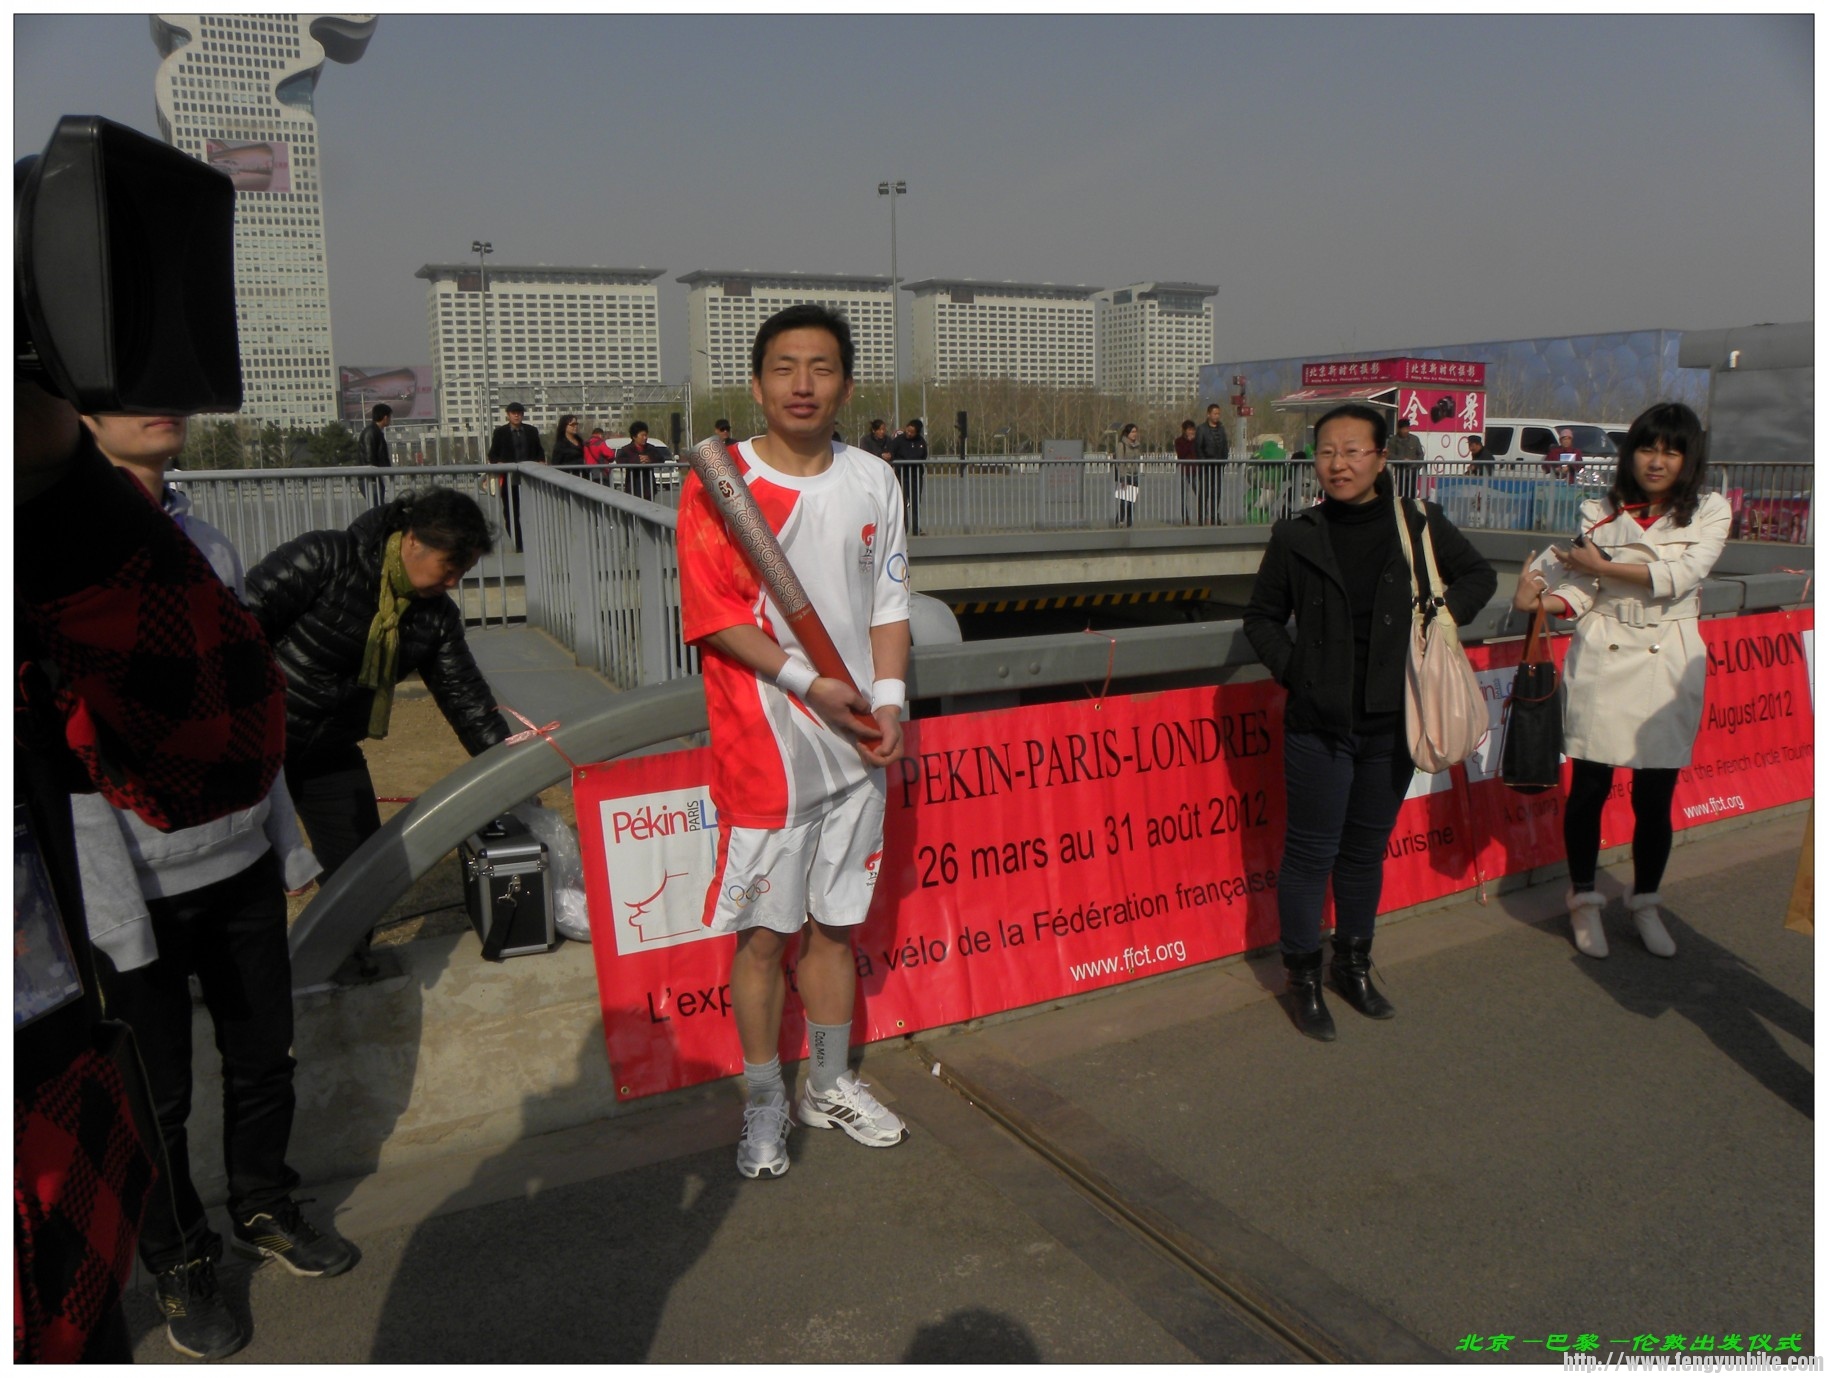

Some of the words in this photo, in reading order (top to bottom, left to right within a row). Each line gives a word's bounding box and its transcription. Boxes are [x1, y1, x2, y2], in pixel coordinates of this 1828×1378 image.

[1706, 632, 1803, 677] S-LONDON
[1707, 698, 1757, 735] August
[1759, 690, 1793, 721] 2012
[901, 710, 1272, 809] PEKIN-PARIS-LONDRES
[1716, 755, 1751, 776] French
[1753, 750, 1780, 769] Cycle
[612, 804, 689, 844] Pékin
[686, 800, 701, 832] PARIS
[1683, 795, 1745, 819] www.ffct.org
[918, 842, 959, 889] 26
[971, 836, 1048, 880] mars
[1059, 829, 1095, 864] au
[1104, 812, 1134, 855] 31
[1147, 802, 1203, 848] août
[1209, 790, 1268, 836] 2012
[856, 946, 874, 978] à
[883, 935, 949, 972] vélo
[957, 926, 991, 957] de
[998, 919, 1025, 948] la
[1033, 892, 1169, 941] Fédération
[1175, 868, 1277, 910] française
[1070, 939, 1187, 981] www.ffct.org
